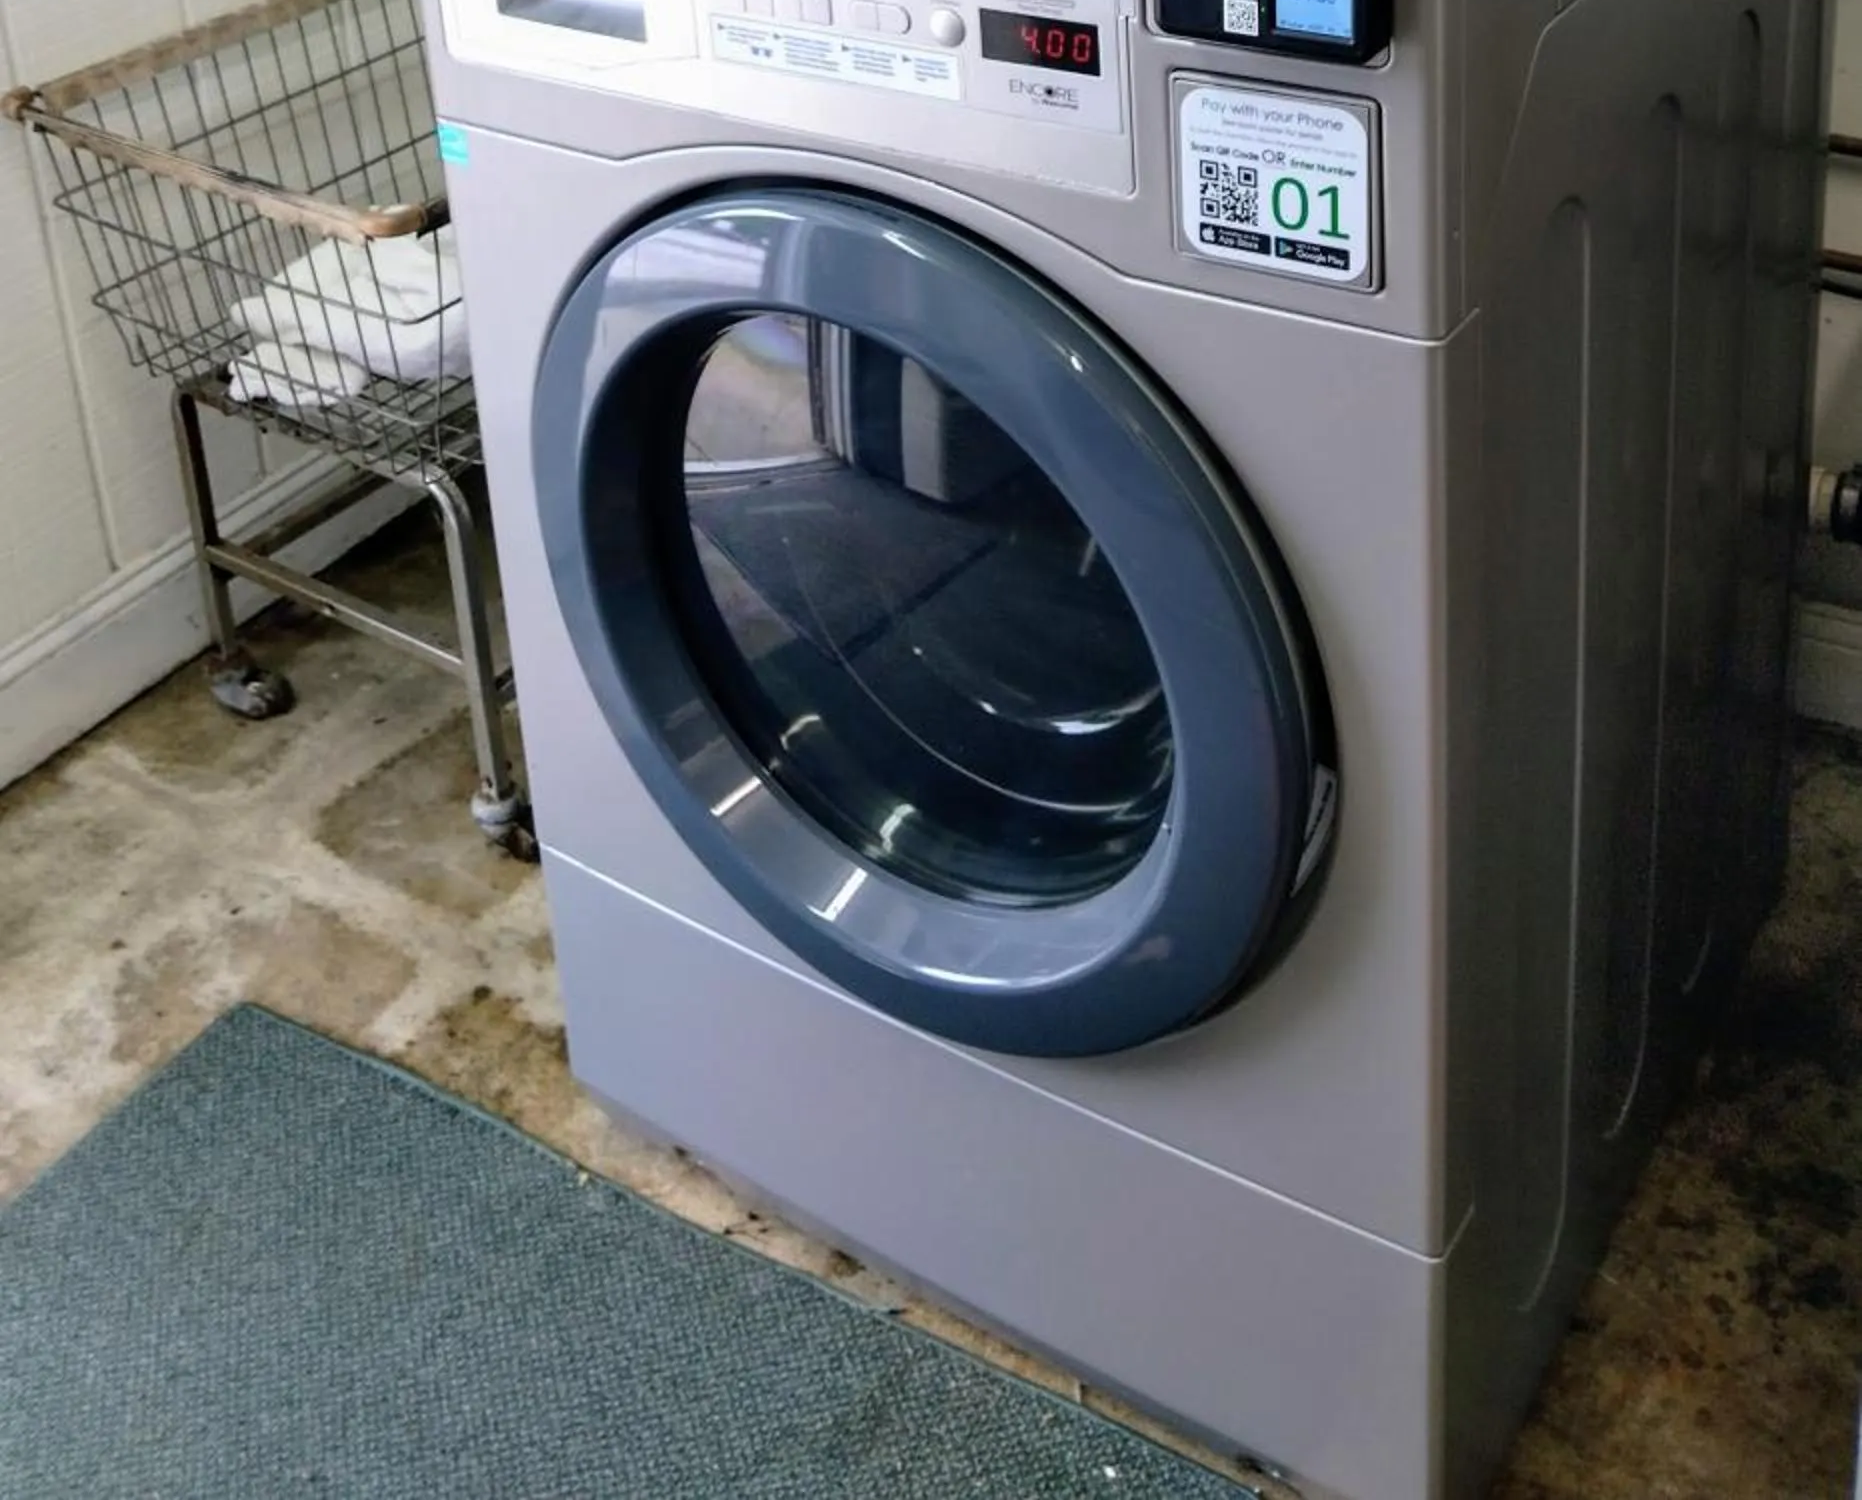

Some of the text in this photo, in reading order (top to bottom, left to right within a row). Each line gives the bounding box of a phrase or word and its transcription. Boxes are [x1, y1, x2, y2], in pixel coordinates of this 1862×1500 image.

[1020, 25, 1092, 63] 4.00
[1009, 79, 1079, 102] ENCORE
[1201, 99, 1226, 114] Pay
[1231, 101, 1259, 117] with
[1264, 108, 1294, 123] your
[1297, 112, 1344, 131] Phone
[1190, 141, 1214, 153] Scan
[1232, 148, 1260, 161] Code
[1261, 149, 1286, 164] OR
[1290, 159, 1315, 170] Enter
[1317, 162, 1357, 177] Number
[1272, 177, 1351, 240] 01
